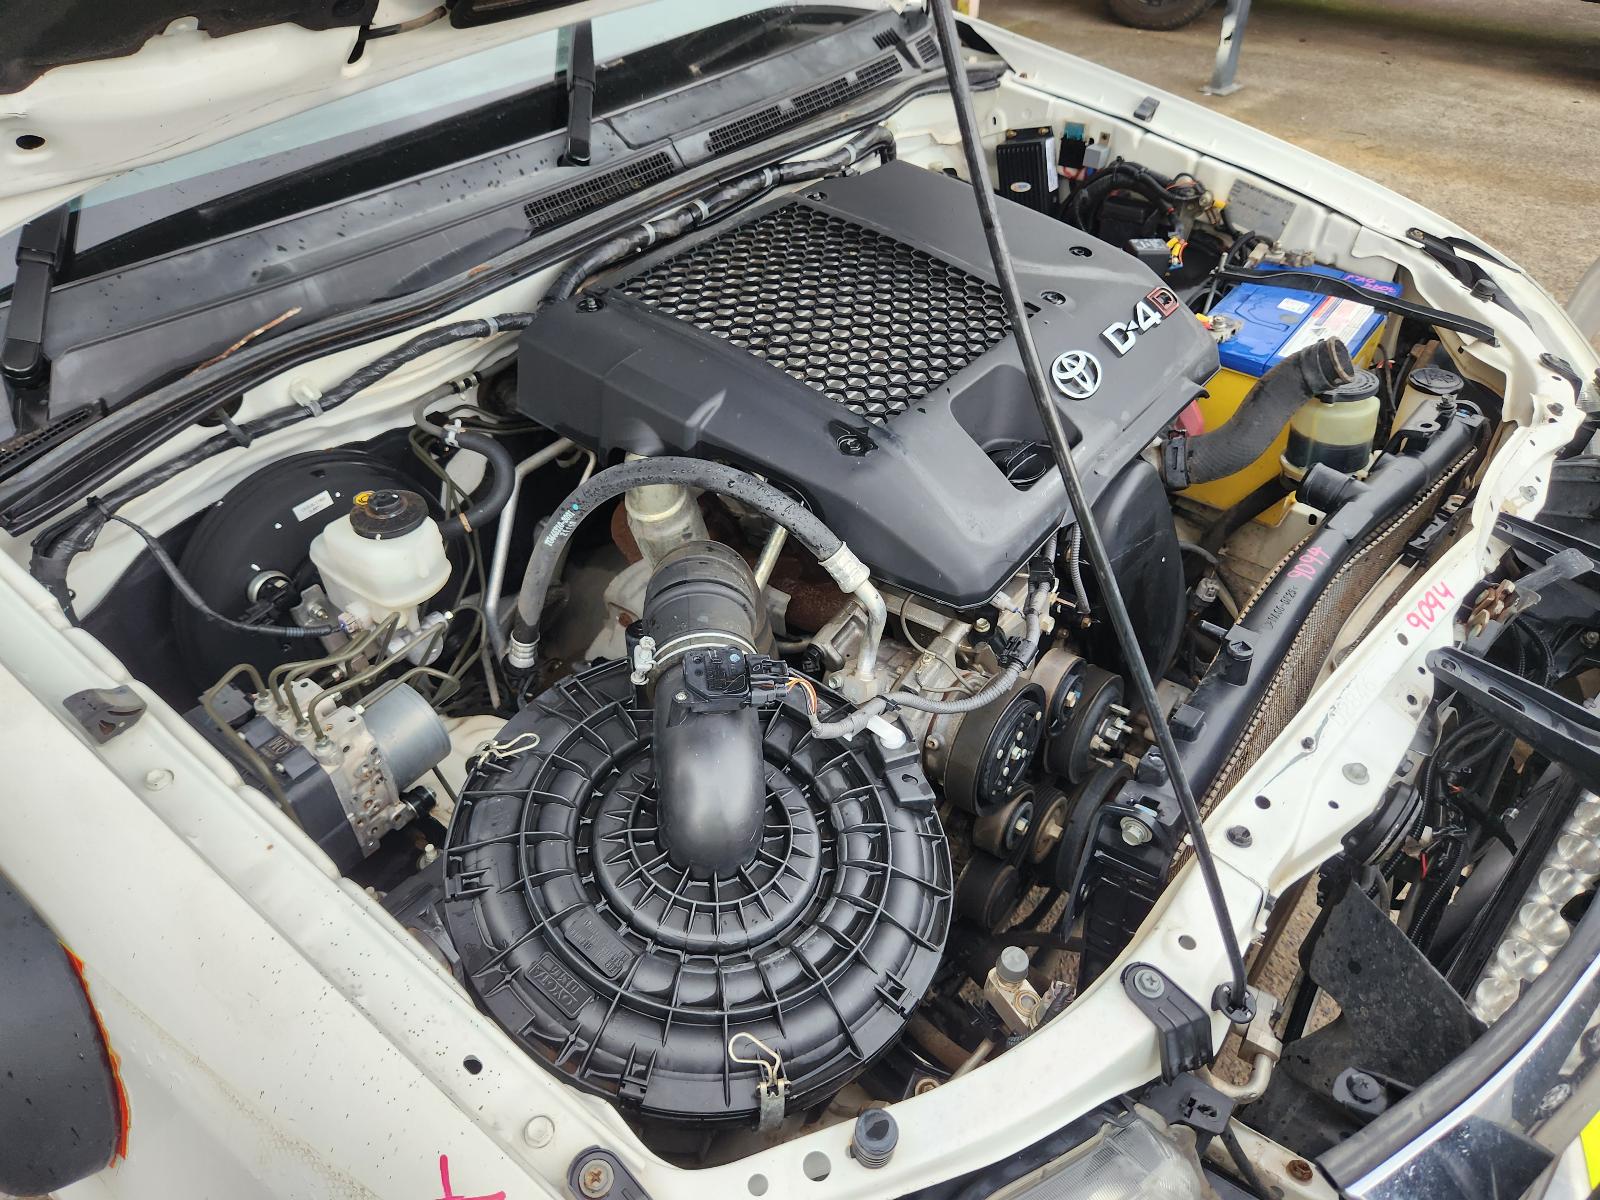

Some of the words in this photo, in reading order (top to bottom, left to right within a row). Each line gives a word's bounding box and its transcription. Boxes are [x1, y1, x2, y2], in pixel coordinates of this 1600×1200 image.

[1099, 286, 1180, 358] D-4D
[1286, 546, 1331, 581] 9094
[1406, 581, 1455, 630] 9094
